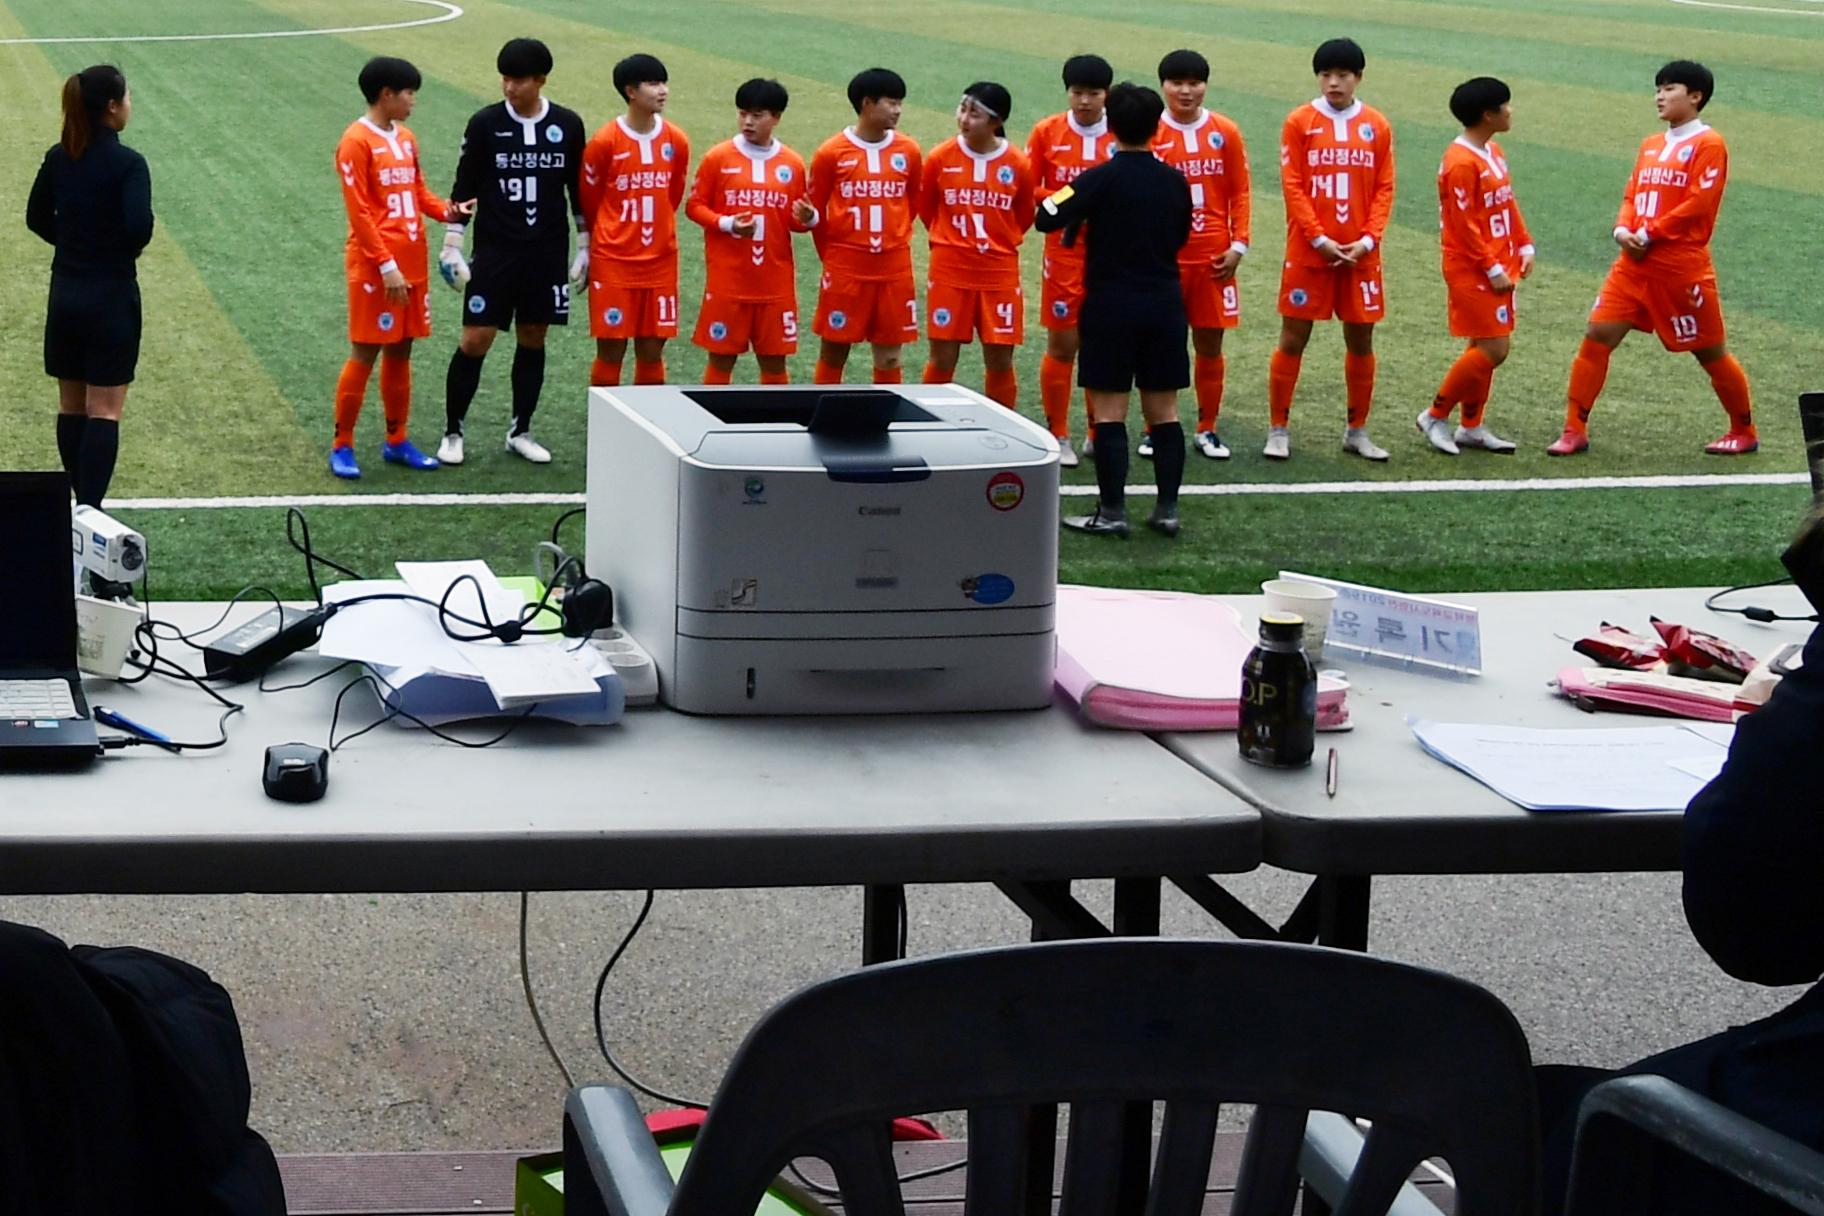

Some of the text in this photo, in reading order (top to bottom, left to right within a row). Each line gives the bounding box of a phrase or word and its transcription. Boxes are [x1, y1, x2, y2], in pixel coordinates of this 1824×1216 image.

[495, 152, 565, 169] 동산정산고
[1308, 148, 1374, 168] 동산정산고
[499, 178, 523, 202] 19
[725, 188, 788, 209] 동산정산고
[840, 180, 906, 199] 동산정산고
[944, 187, 1013, 211] 동산정산고
[657, 295, 675, 320] 11
[997, 302, 1014, 326] 4
[782, 311, 797, 333] 5
[1670, 315, 1697, 337] 10
